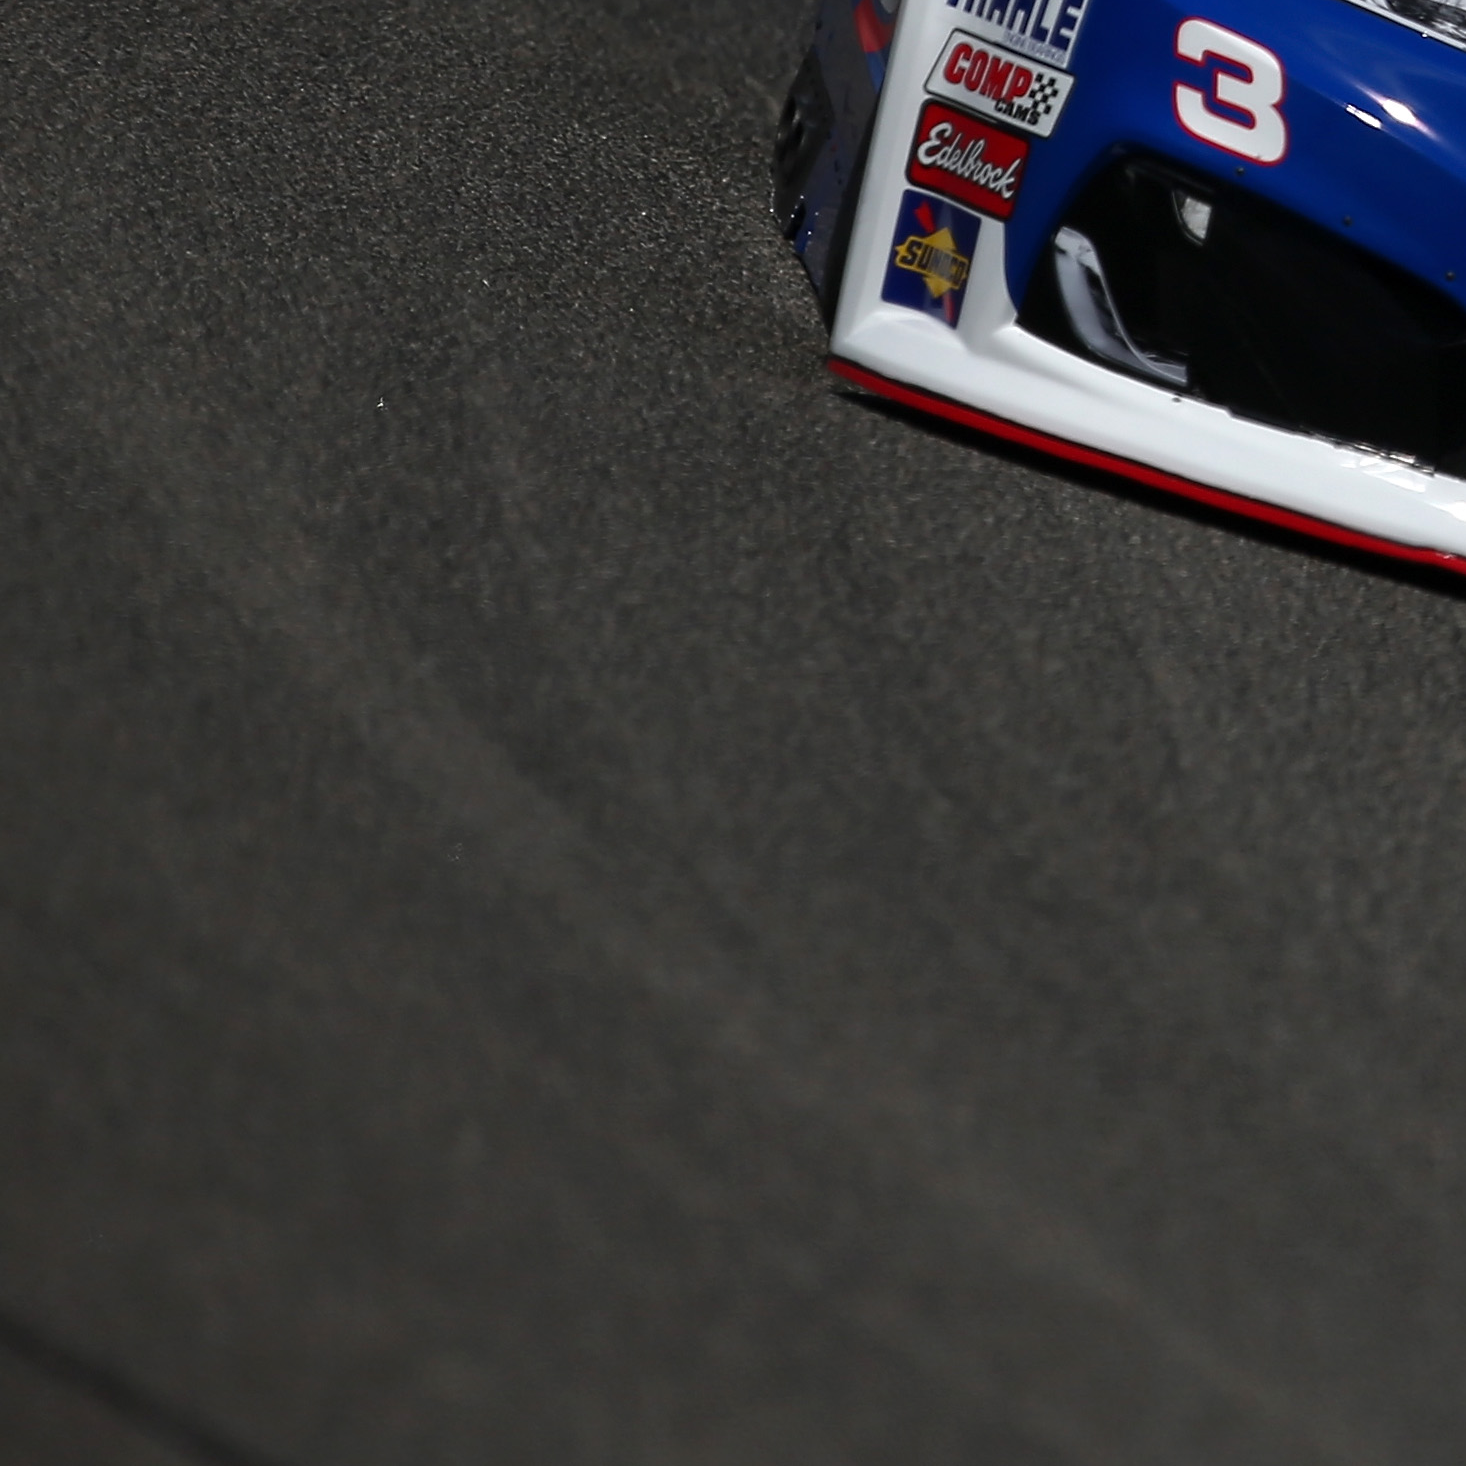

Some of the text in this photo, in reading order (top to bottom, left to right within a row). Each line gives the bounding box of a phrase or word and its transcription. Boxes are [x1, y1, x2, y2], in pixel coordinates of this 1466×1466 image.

[943, 42, 1034, 105] COMP
[1173, 15, 1291, 168] 3
[994, 98, 1042, 128] CAMS
[917, 121, 1022, 199] Edelbrock
